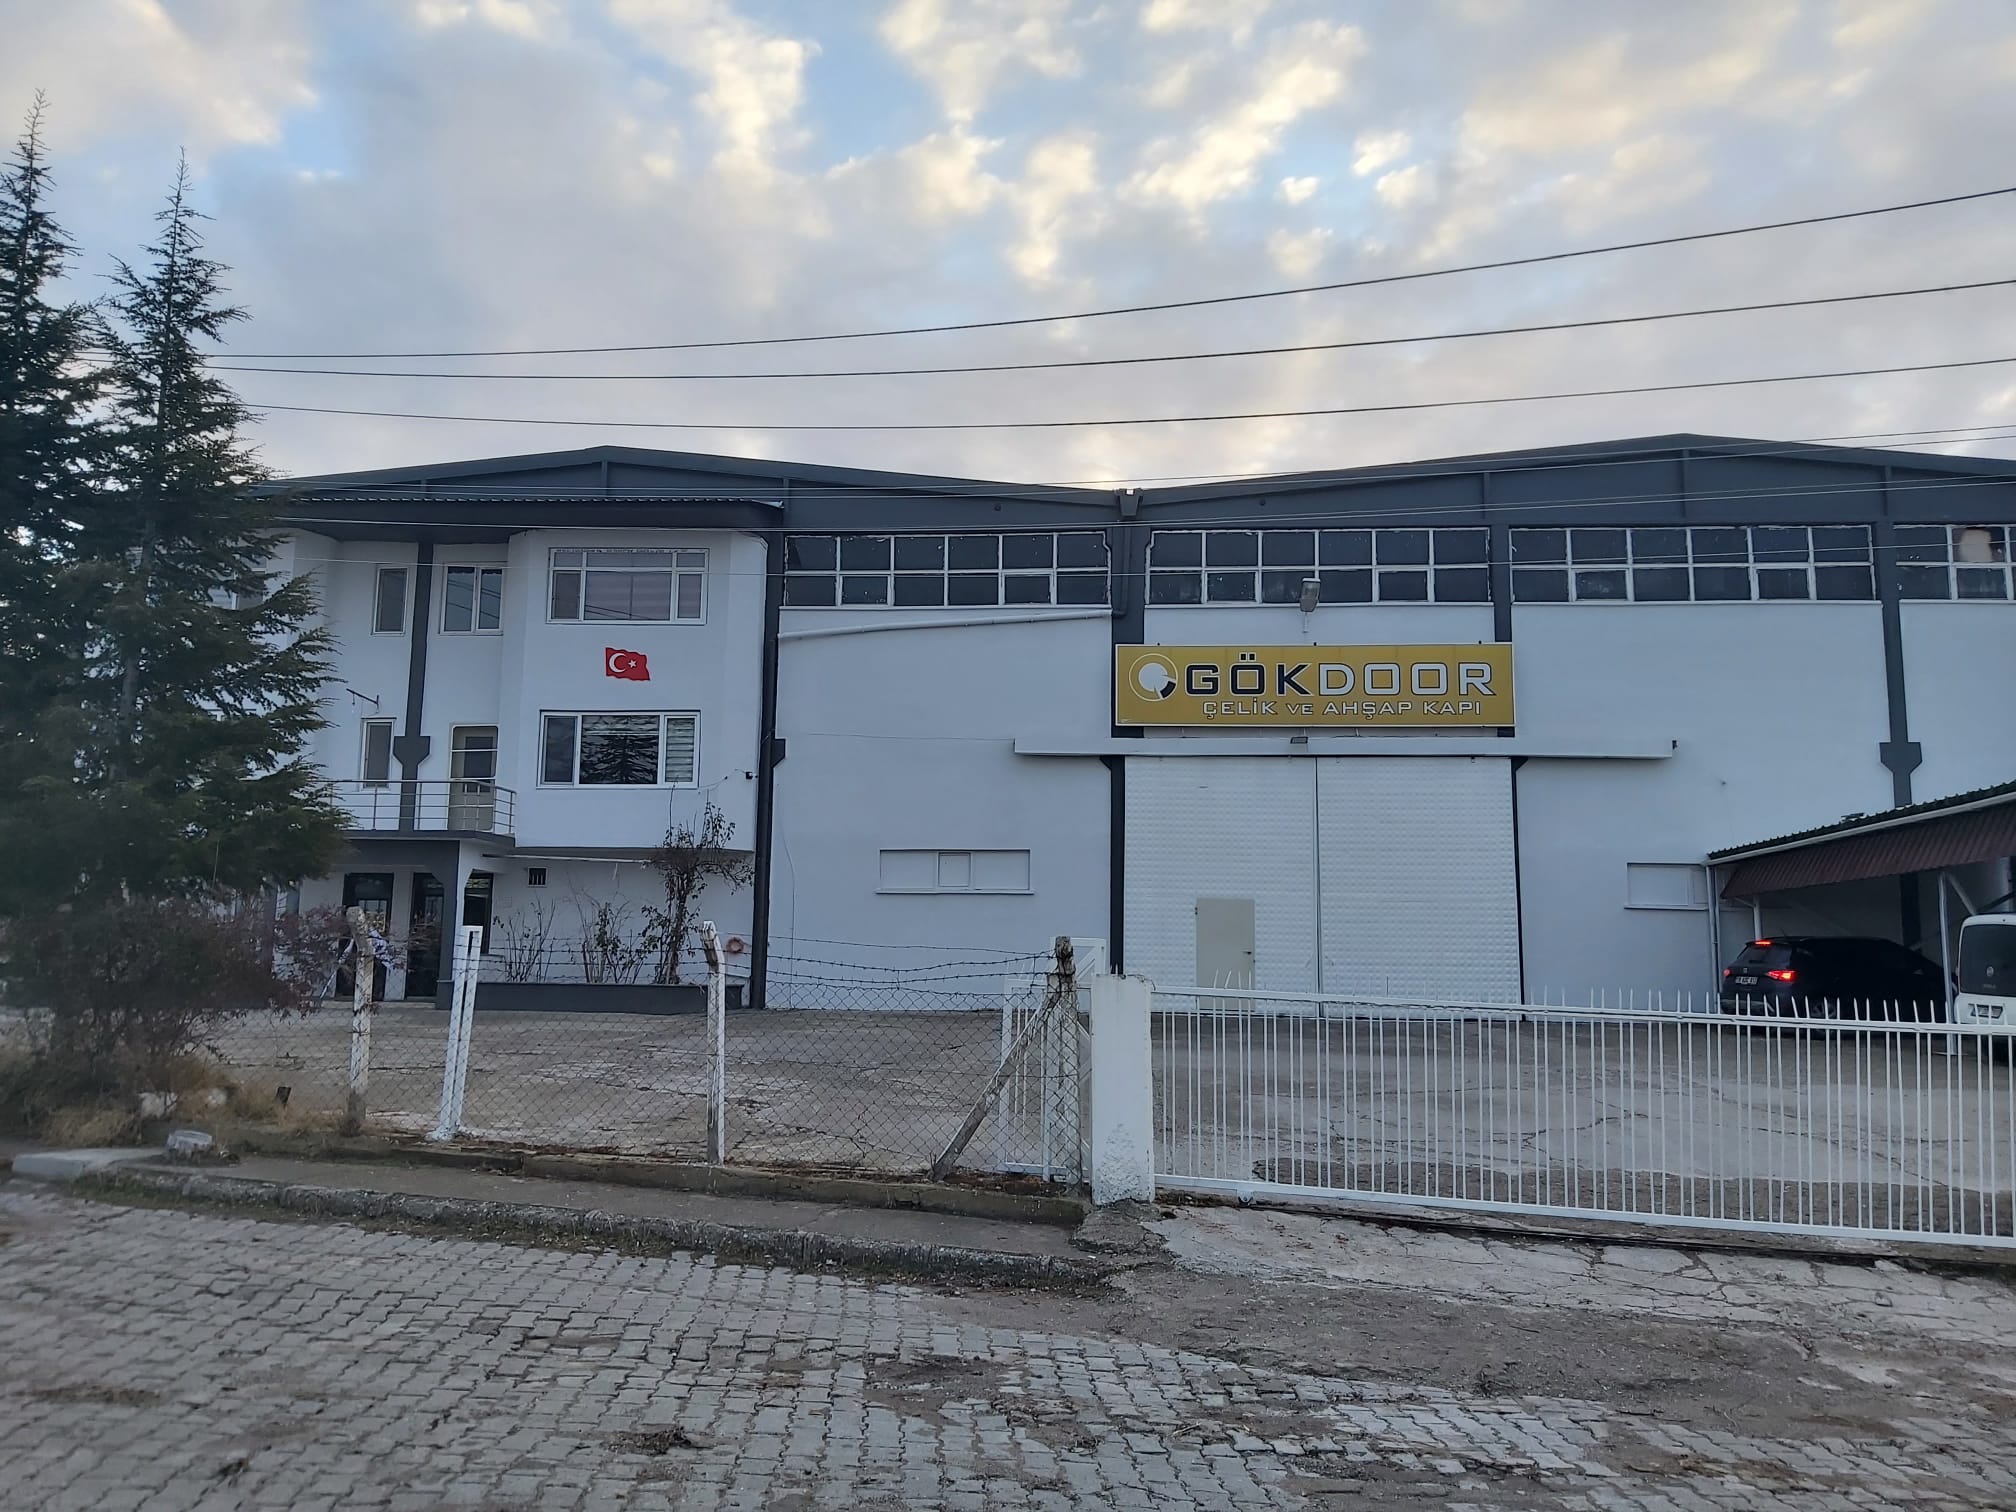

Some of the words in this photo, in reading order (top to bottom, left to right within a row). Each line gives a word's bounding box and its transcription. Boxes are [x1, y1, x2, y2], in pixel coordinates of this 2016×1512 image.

[1185, 652, 1496, 697] GÖKDOOR
[1203, 698, 1277, 719] ÇELİK
[1286, 703, 1313, 715] VE
[1323, 701, 1413, 720] AHŞAP
[1423, 701, 1481, 715] KAPI
